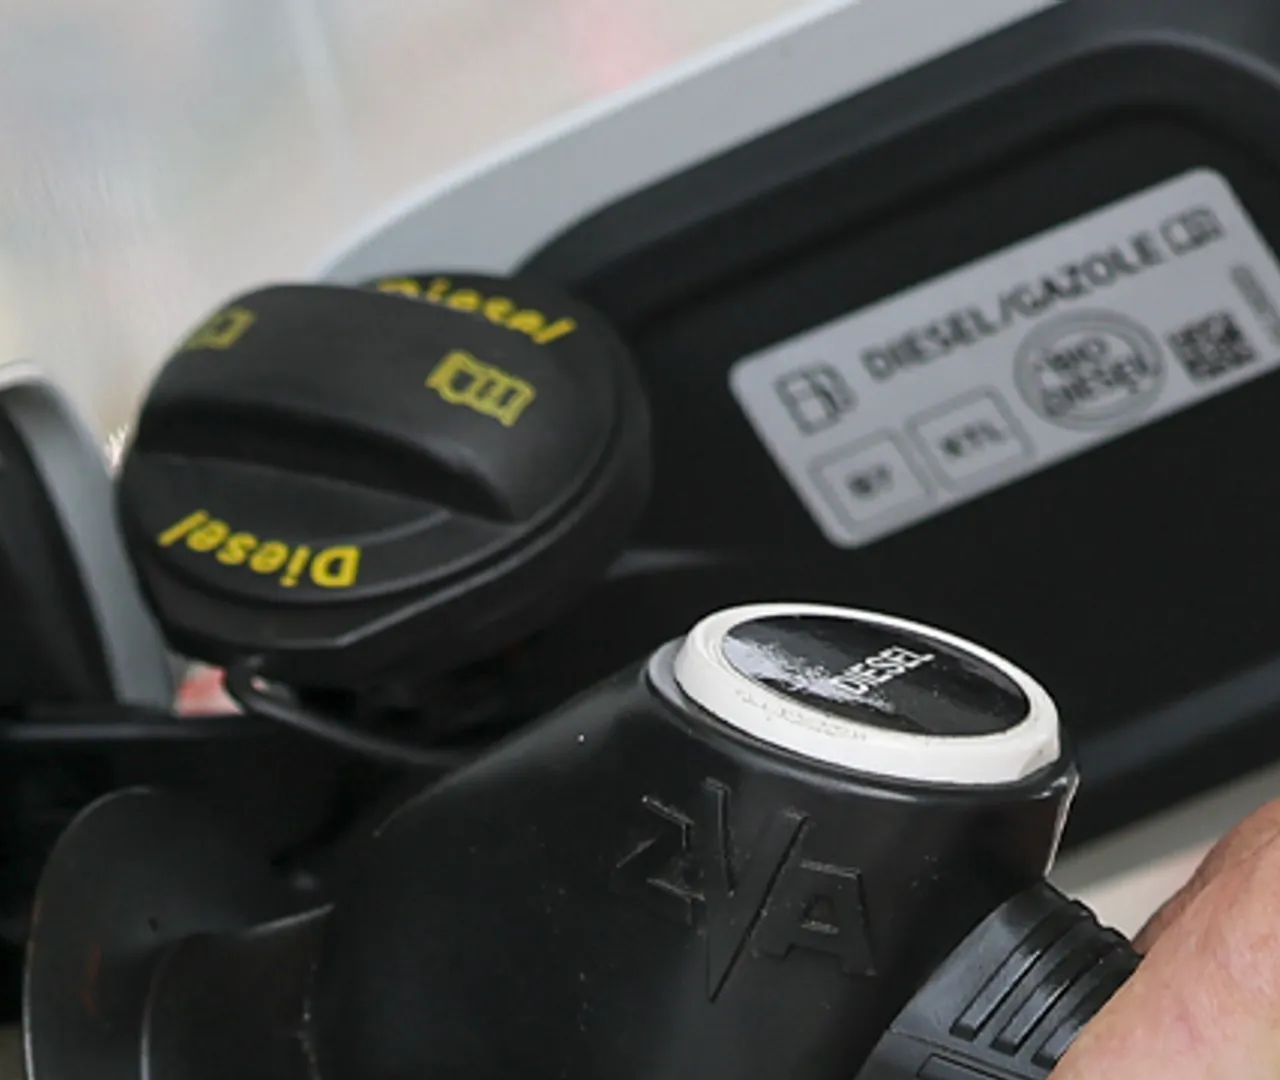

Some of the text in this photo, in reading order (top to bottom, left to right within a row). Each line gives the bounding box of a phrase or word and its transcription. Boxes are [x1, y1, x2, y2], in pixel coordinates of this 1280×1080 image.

[859, 233, 1168, 383] DIESEL/GAZOLE
[158, 510, 361, 588] Diesel
[830, 645, 936, 697] DIESEL
[616, 776, 877, 1004] ZVA
